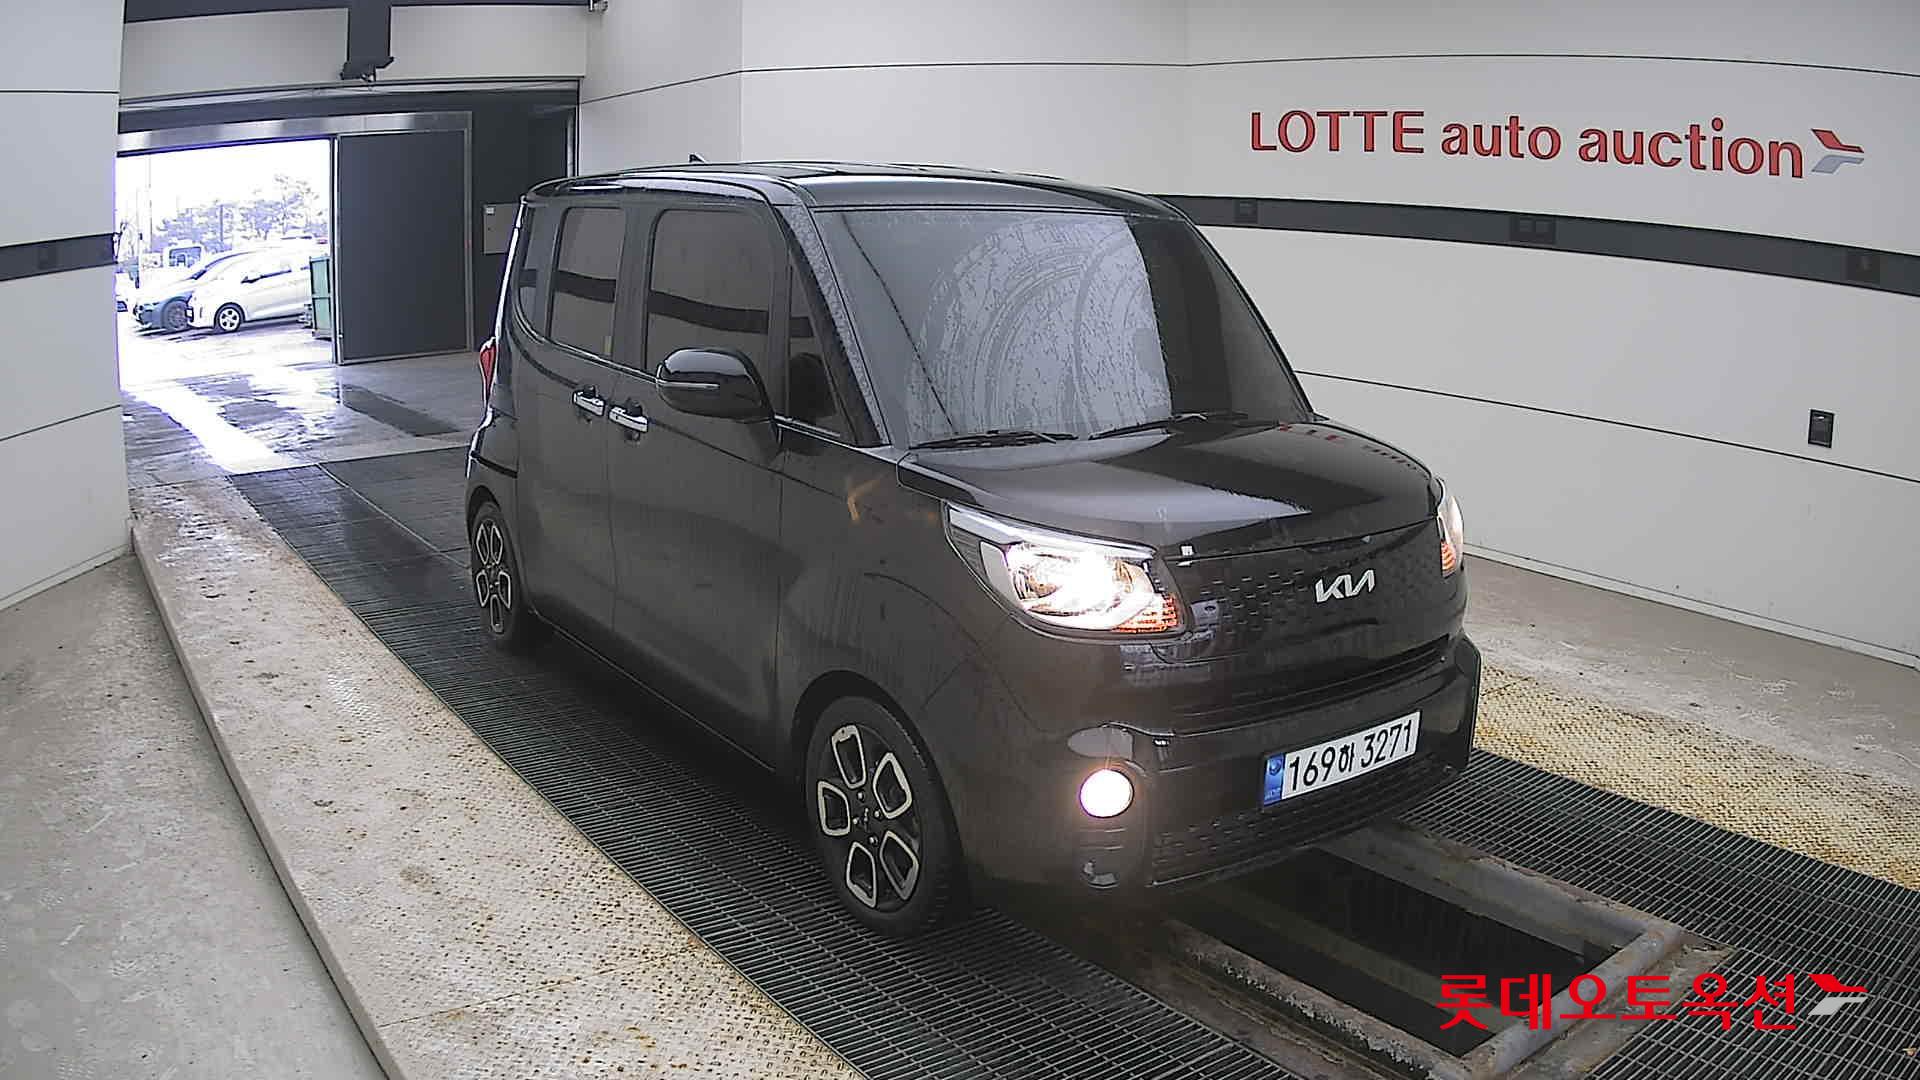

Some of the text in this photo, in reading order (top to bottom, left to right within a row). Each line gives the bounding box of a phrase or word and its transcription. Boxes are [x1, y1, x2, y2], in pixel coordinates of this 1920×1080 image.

[1250, 110, 1804, 179] LOTTE auto auction
[1314, 569, 1375, 603] KIA
[1289, 719, 1412, 791] 169하 3271
